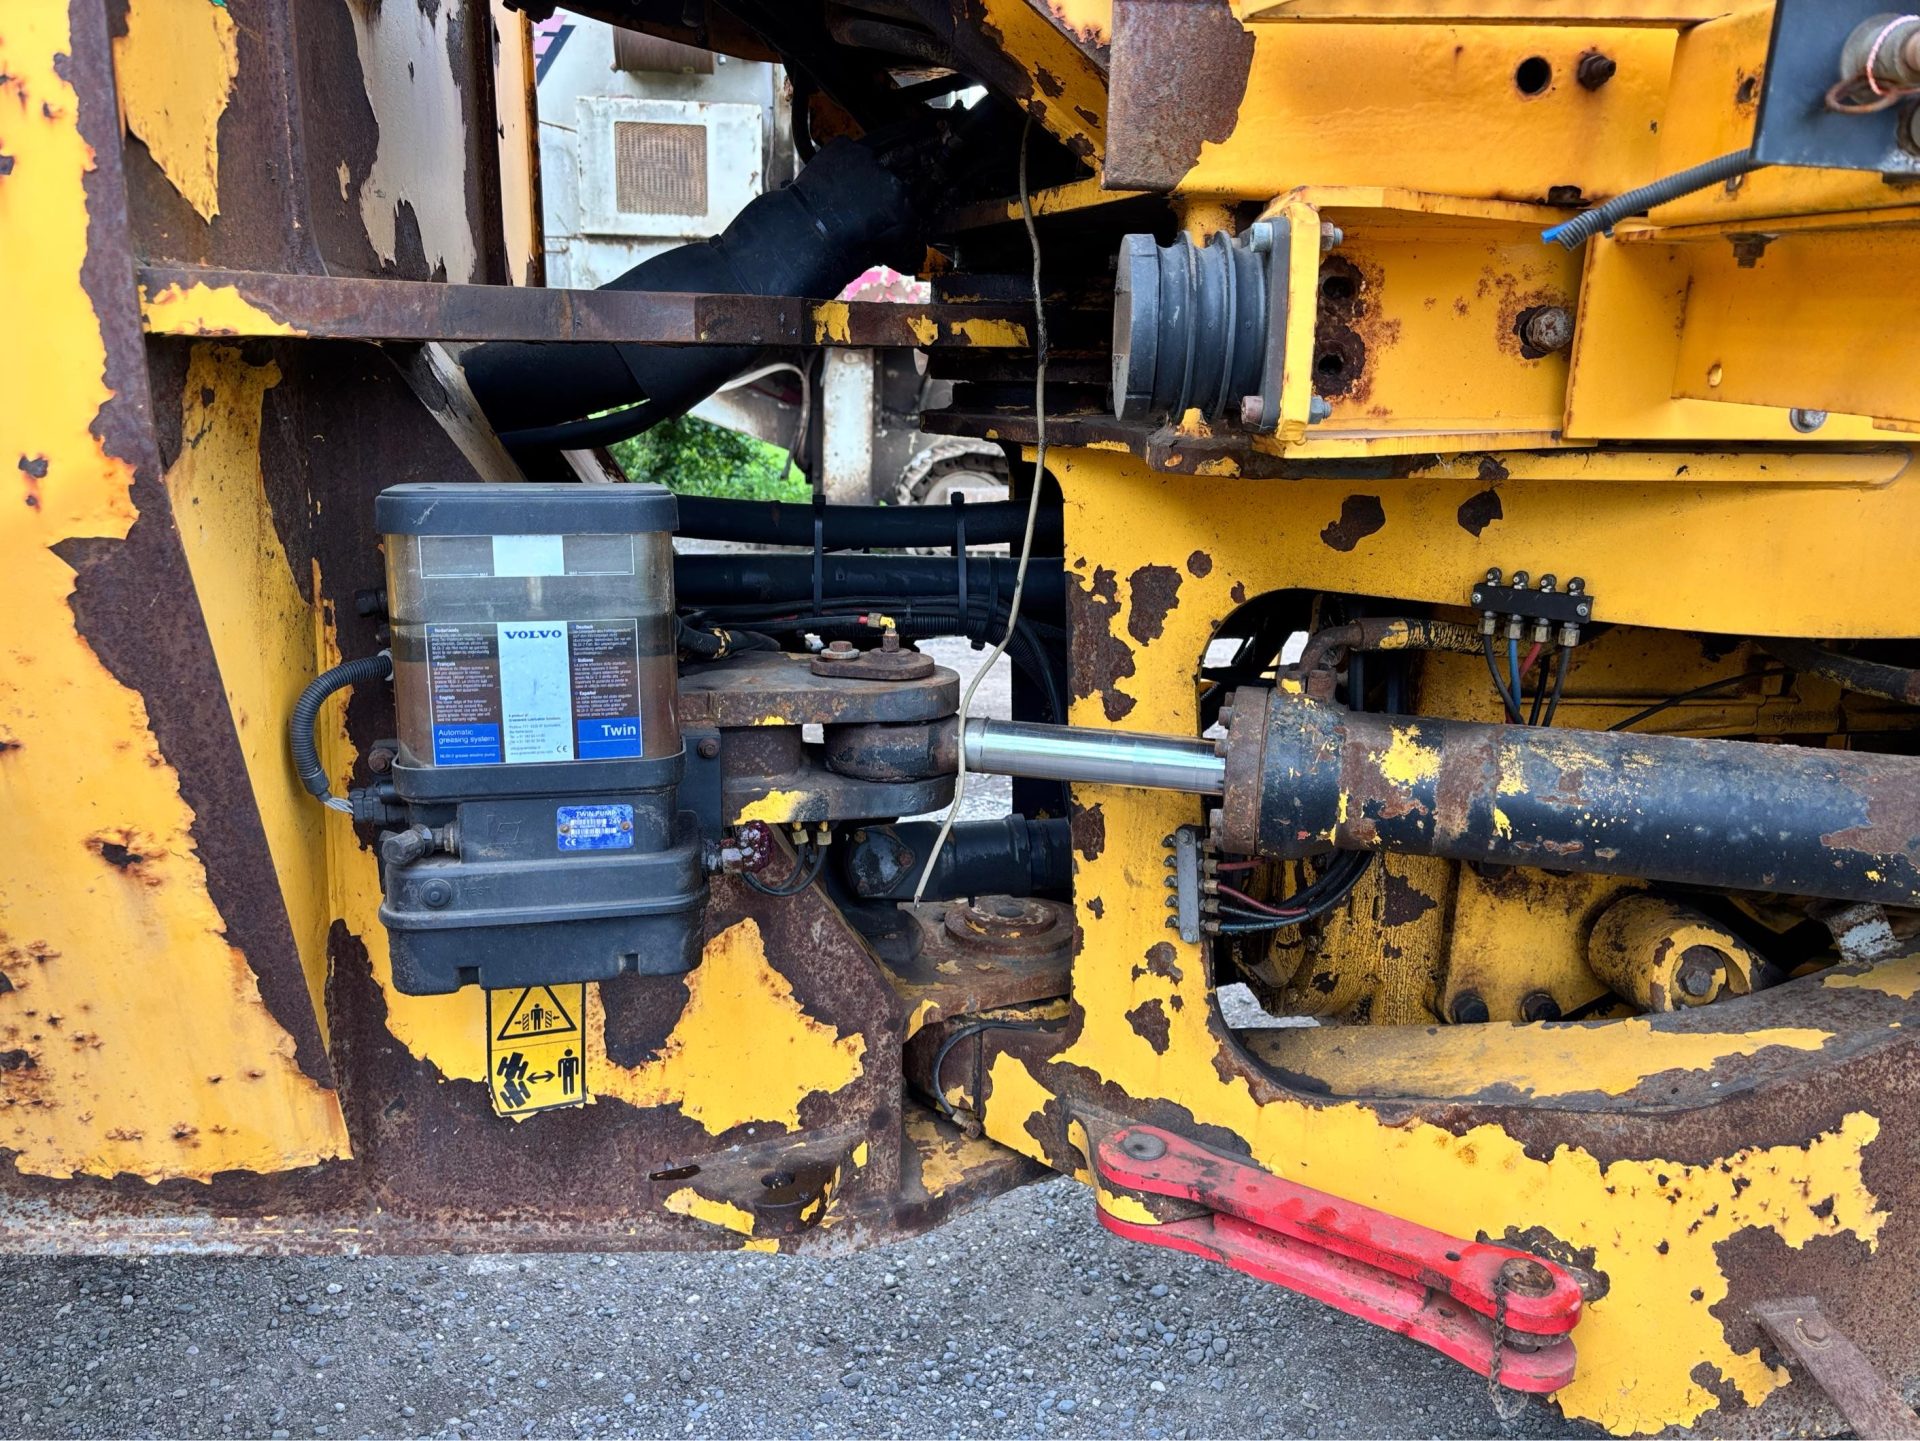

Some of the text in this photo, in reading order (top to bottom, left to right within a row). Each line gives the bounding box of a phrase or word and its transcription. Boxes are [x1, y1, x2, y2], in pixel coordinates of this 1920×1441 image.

[504, 629, 562, 640] VOLVO
[438, 729, 474, 737] Automatic
[600, 723, 637, 737] Twin
[438, 735, 495, 745] greasing system
